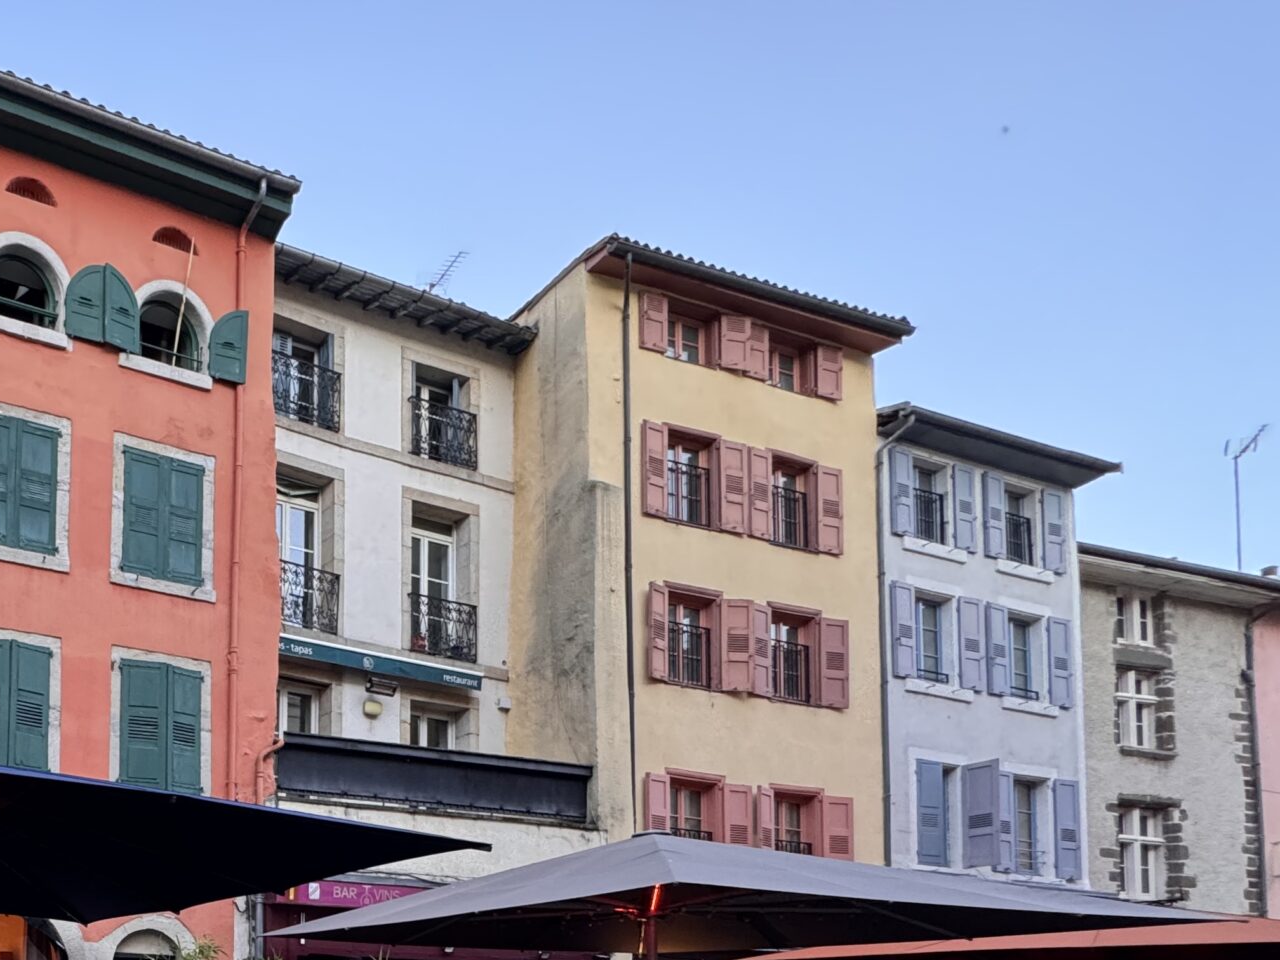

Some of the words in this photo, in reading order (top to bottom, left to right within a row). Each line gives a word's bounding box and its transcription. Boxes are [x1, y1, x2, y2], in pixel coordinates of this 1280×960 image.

[291, 643, 313, 655] tapas
[443, 674, 478, 688] restaurant
[333, 886, 357, 899] BAR
[374, 888, 400, 901] VINS
